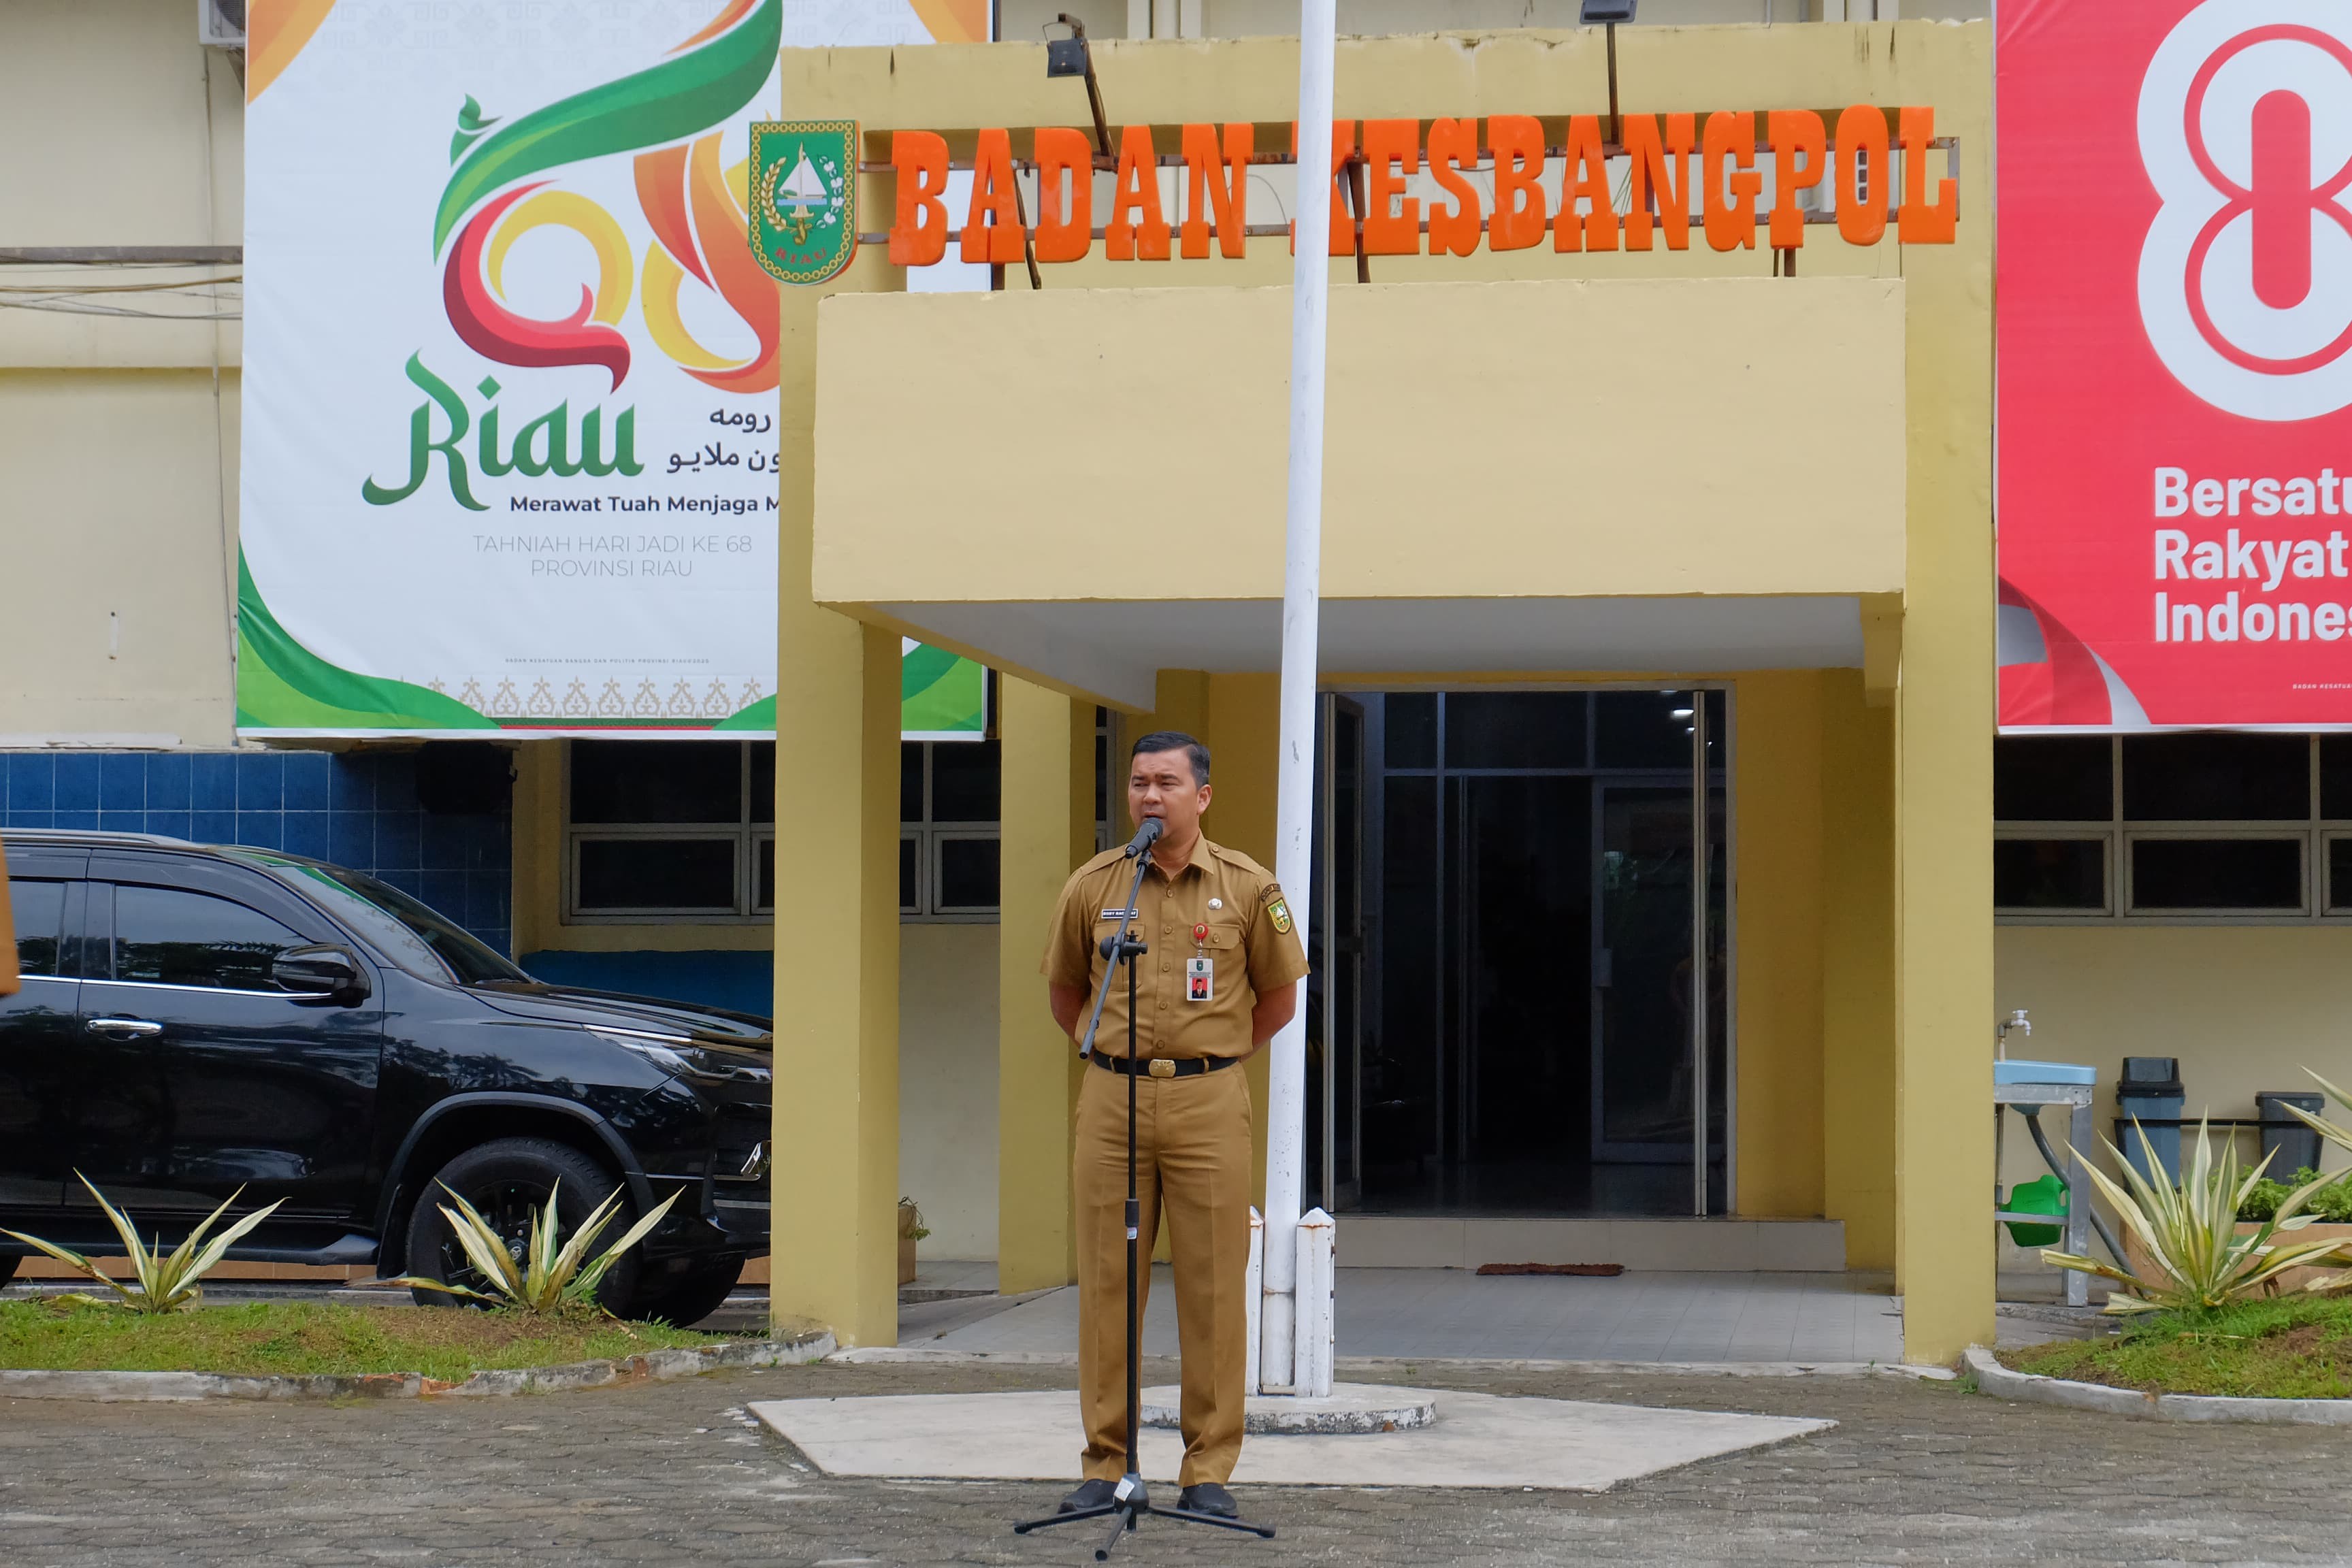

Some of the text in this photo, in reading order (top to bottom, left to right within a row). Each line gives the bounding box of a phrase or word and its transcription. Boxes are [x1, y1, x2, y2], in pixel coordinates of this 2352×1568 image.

[889, 122, 1254, 266] BADAN
[774, 247, 826, 264] RIAU
[361, 348, 645, 512] Riau
[510, 495, 602, 512] Merawat
[608, 495, 660, 512] Tuah
[667, 494, 758, 516] Menjaga
[2155, 467, 2352, 517] Bersat
[473, 535, 752, 553] TAHNIAH HARI JADI KE 68
[532, 559, 692, 577] PROVINSI RIAU
[2155, 528, 2349, 591] Rakyat
[2155, 591, 2352, 642] Indone
